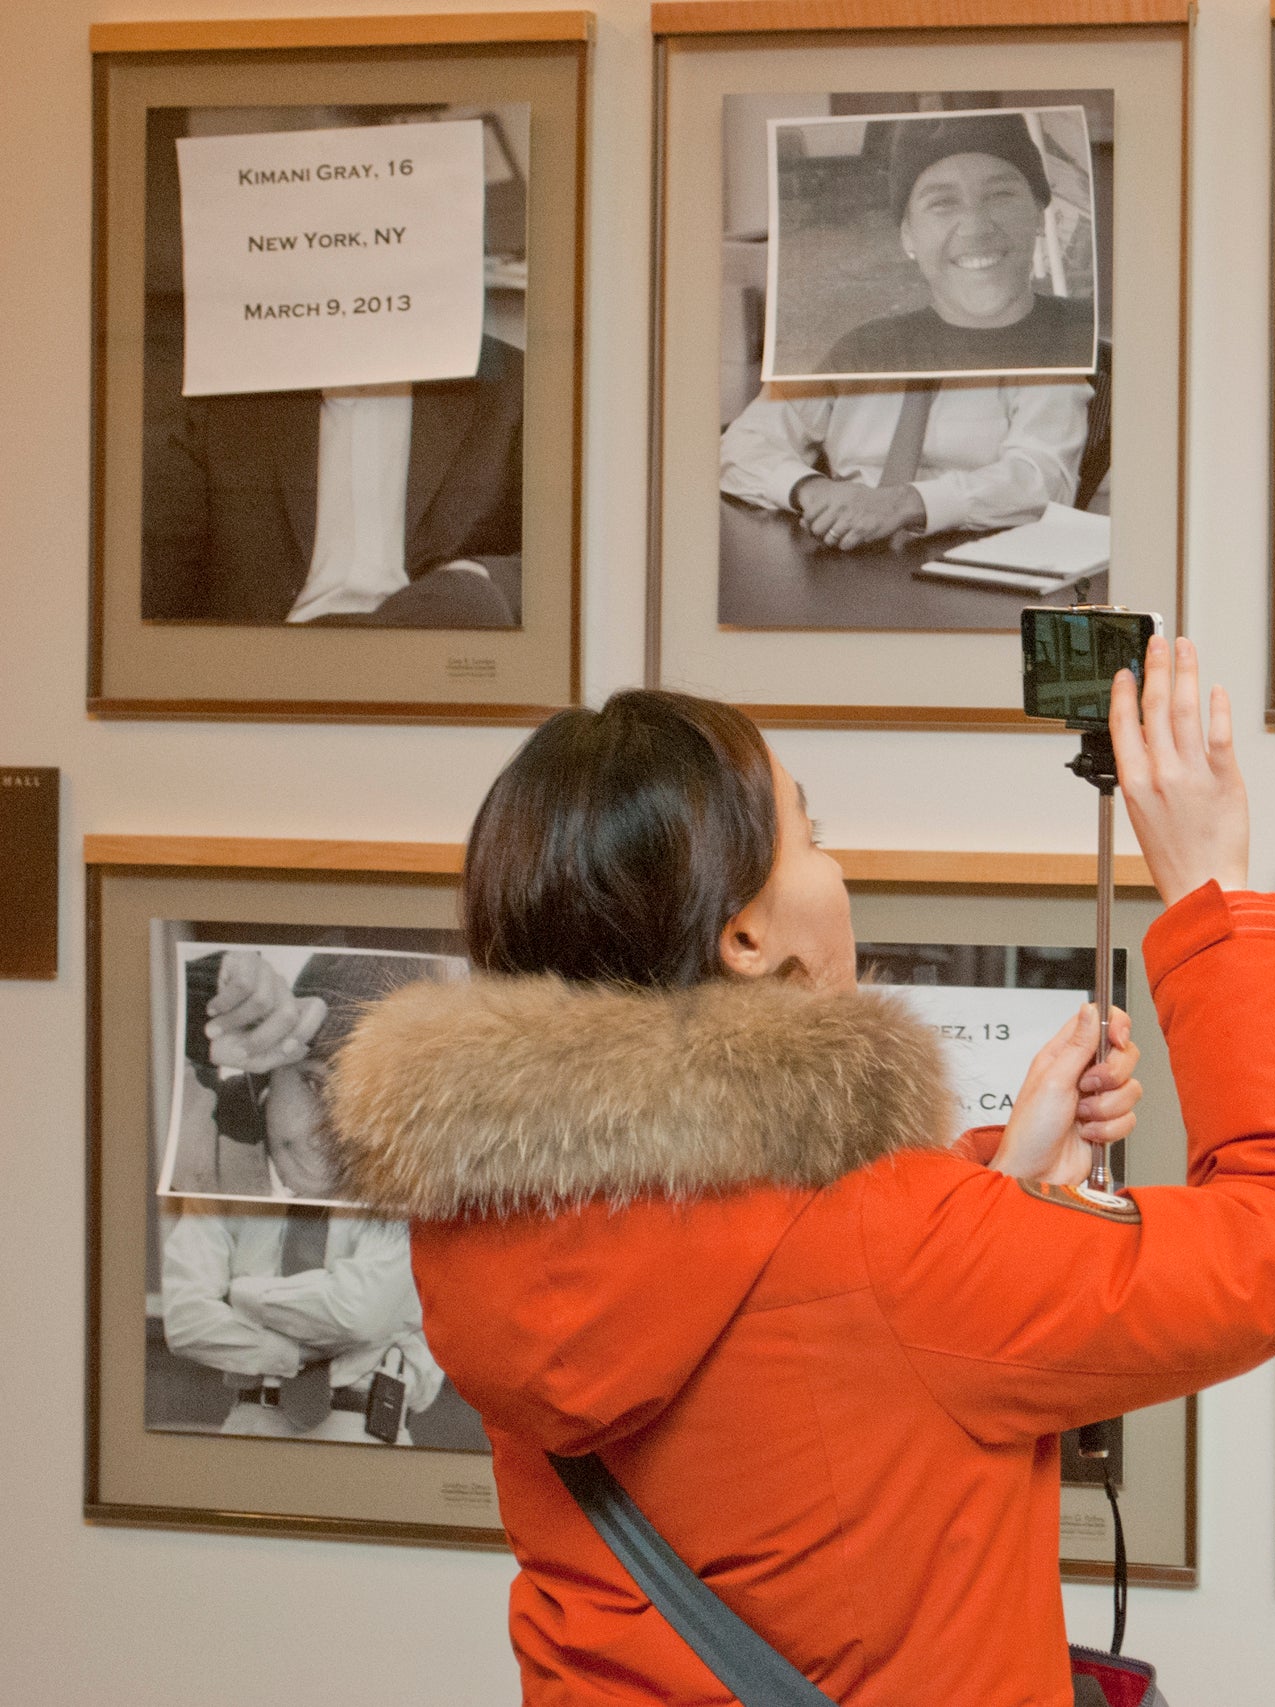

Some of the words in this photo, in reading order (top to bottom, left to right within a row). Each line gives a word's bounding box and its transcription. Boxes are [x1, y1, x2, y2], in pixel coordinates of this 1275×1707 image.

[238, 168, 311, 186] KIMANI
[316, 163, 379, 181] GRAY,
[388, 158, 414, 177] 16
[248, 235, 298, 252] NEW
[303, 231, 367, 249] YORK,
[374, 226, 407, 245] NY
[244, 302, 320, 321] MARCH
[326, 299, 346, 316] 9,
[353, 294, 412, 314] 2013
[983, 1024, 1010, 1040] 13
[979, 1092, 1015, 1111] CA
